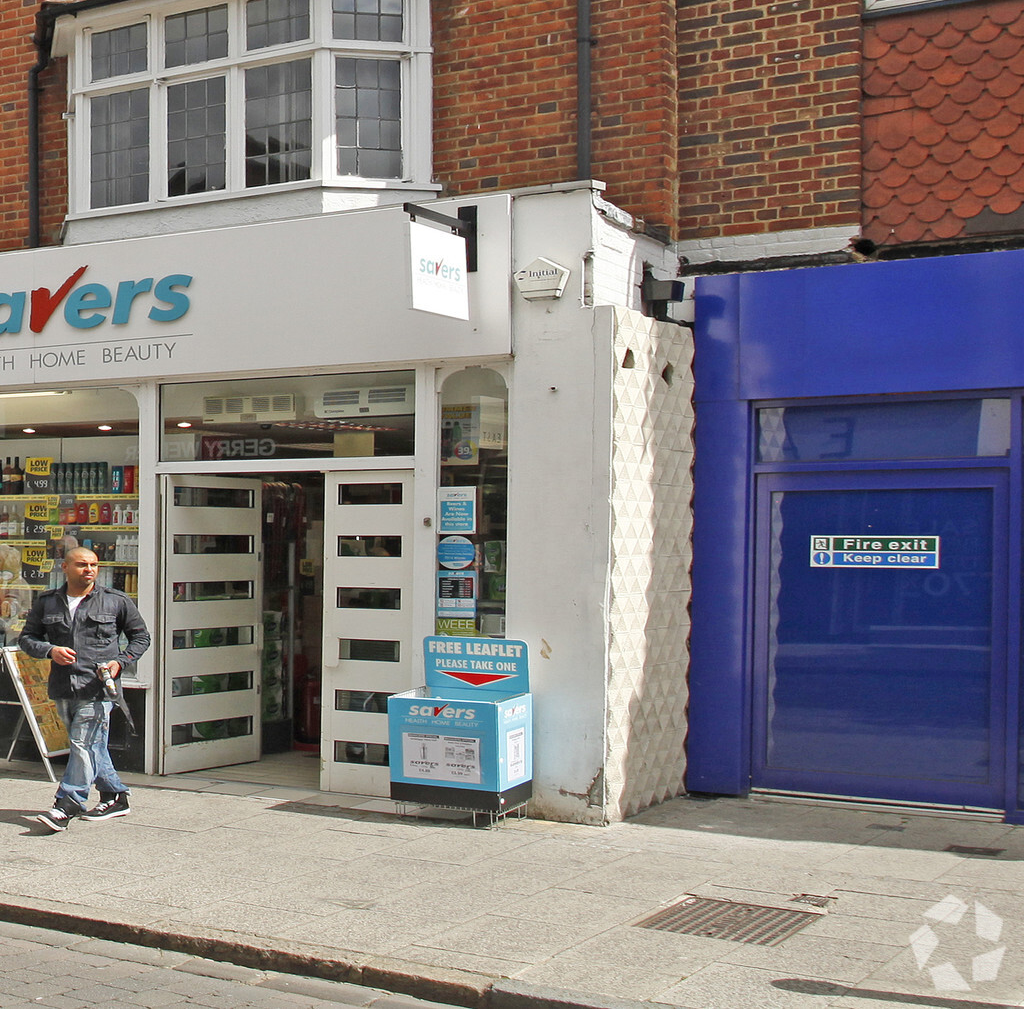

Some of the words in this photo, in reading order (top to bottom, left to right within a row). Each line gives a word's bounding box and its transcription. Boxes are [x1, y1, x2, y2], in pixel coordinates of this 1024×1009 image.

[419, 258, 461, 282] savers
[528, 268, 558, 278] Initial
[29, 349, 86, 369] HOME
[102, 342, 177, 364] BEAUTY
[34, 480, 48, 488] 4.99
[843, 539, 882, 550] Fire
[888, 539, 928, 550] exit
[843, 553, 882, 564] Keep
[887, 554, 927, 563] clear
[438, 620, 475, 629] WEEE
[429, 641, 462, 654] FREE
[466, 643, 523, 657] LEAFLET
[436, 658, 468, 669] PLEASE
[470, 660, 493, 670] TAKE
[496, 662, 517, 671] ONE
[408, 703, 476, 719] savers
[504, 705, 526, 718] savers
